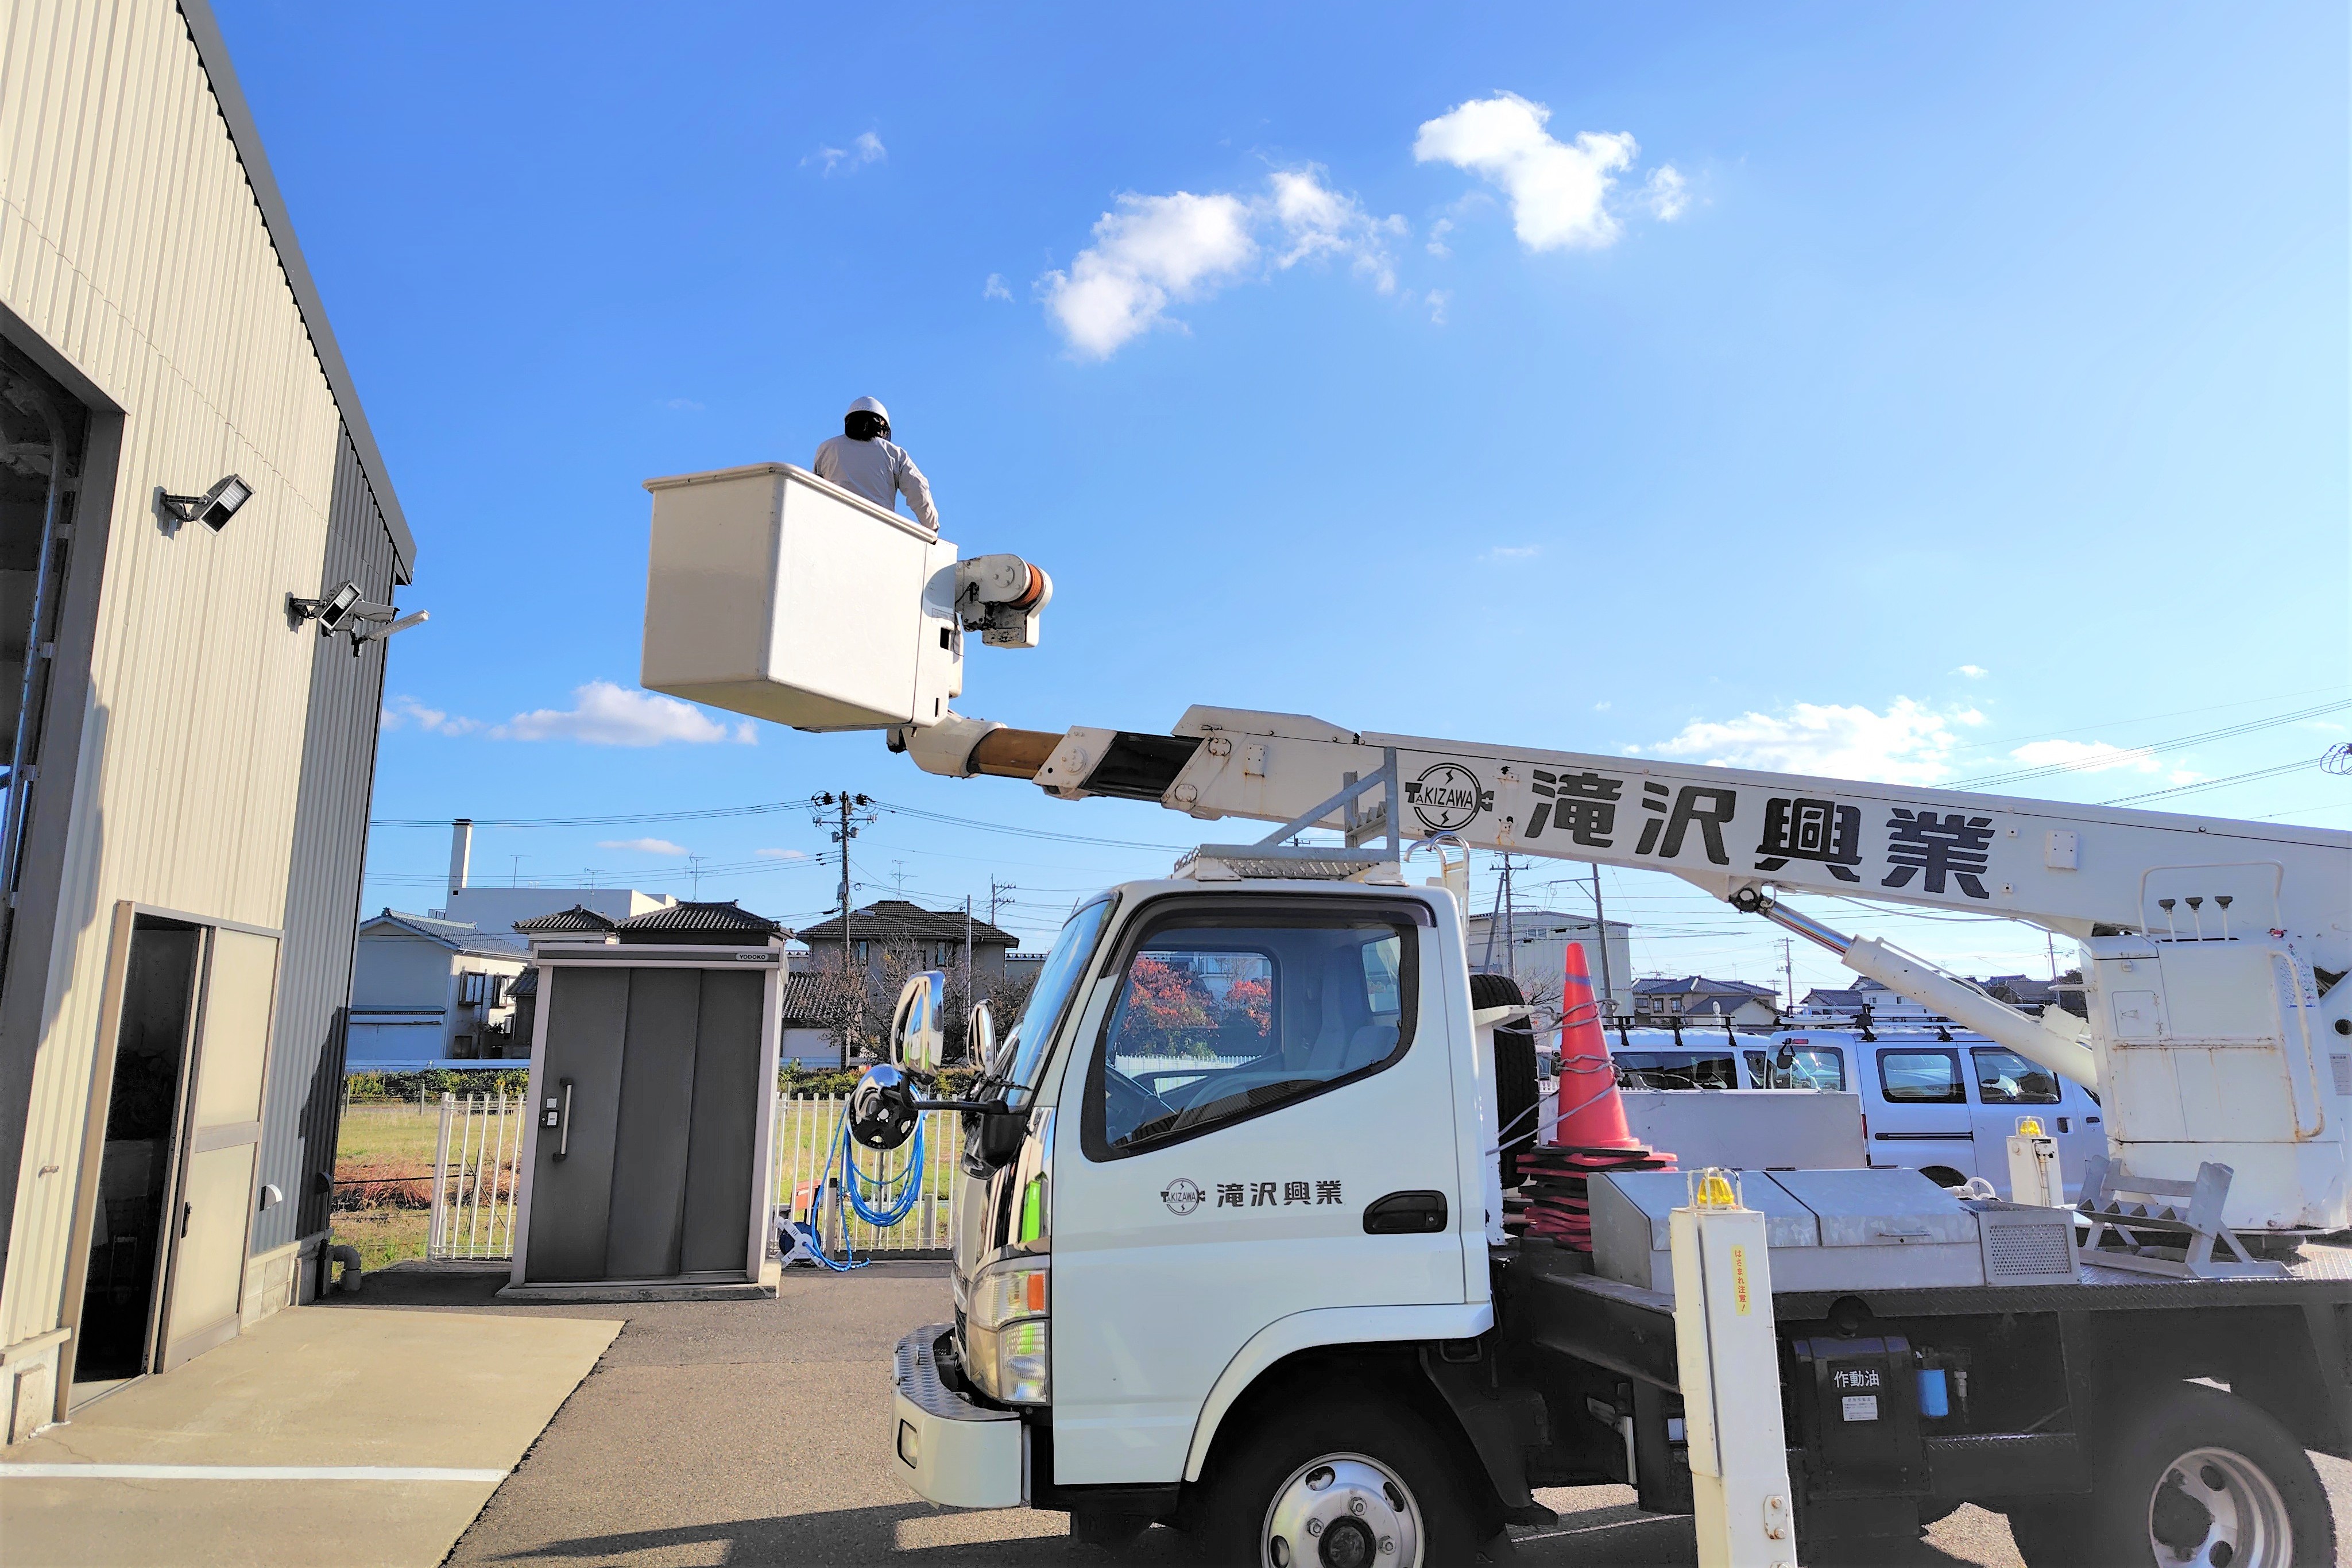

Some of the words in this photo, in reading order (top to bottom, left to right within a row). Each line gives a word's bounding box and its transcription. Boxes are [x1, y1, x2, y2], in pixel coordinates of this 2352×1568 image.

[1525, 769, 1995, 899] 滝沢興業
[1217, 1180, 1343, 1207] 滝沢興業
[1833, 1369, 1879, 1388] 作動油
